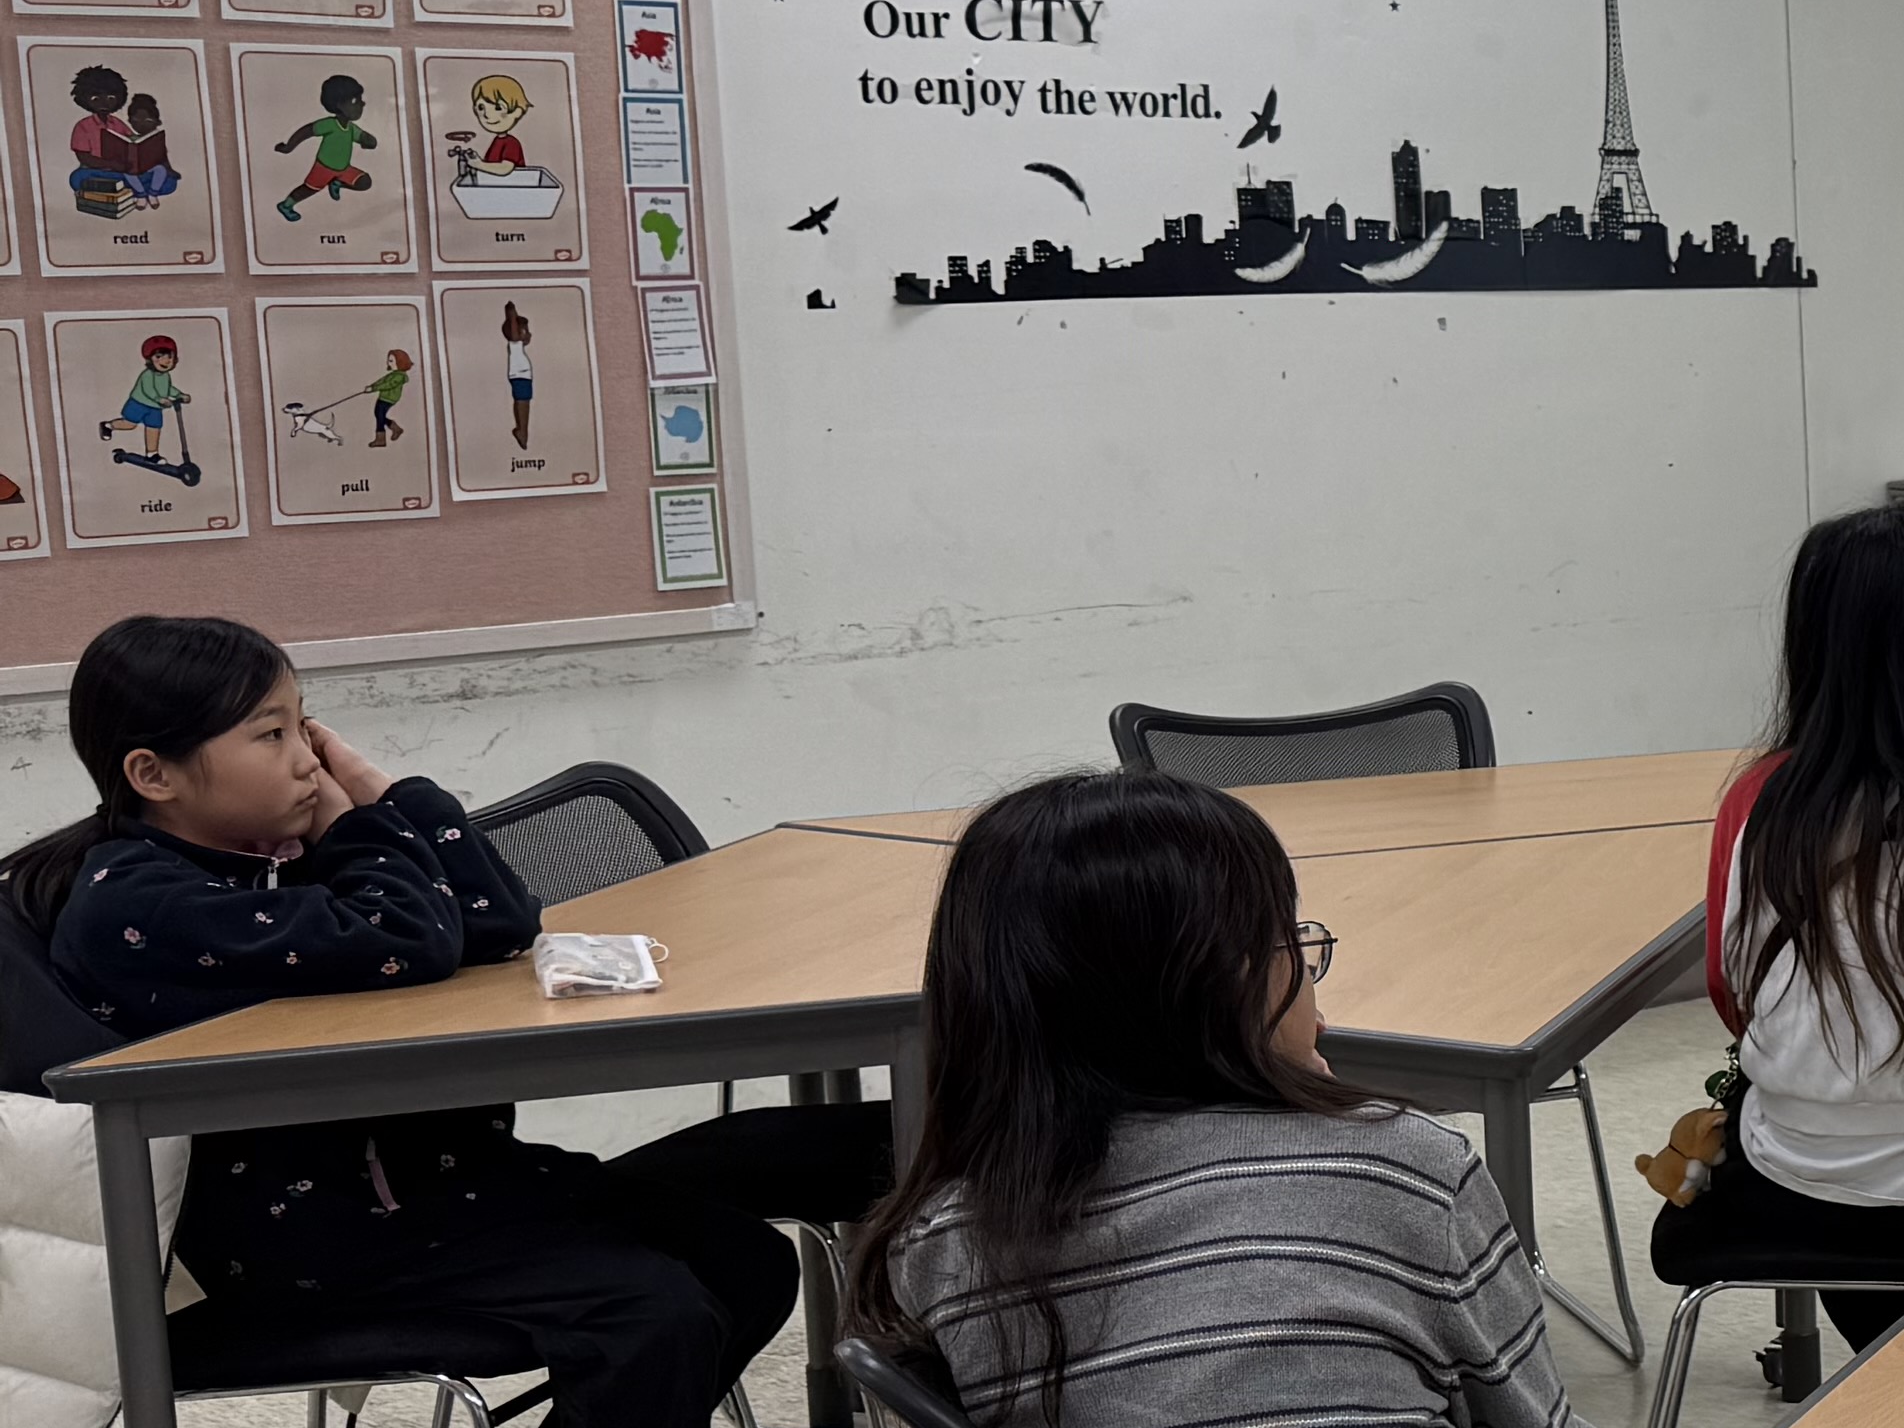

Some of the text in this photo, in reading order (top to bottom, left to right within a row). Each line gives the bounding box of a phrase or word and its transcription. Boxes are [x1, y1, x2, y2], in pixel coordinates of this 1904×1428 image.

[863, 0, 950, 39] Our
[858, 67, 1223, 119] to enjoy the world.
[113, 230, 150, 244] read
[320, 234, 347, 244] run
[495, 231, 526, 243] turn
[511, 457, 546, 473] jump
[341, 479, 370, 496] pull
[140, 499, 173, 513] ride
